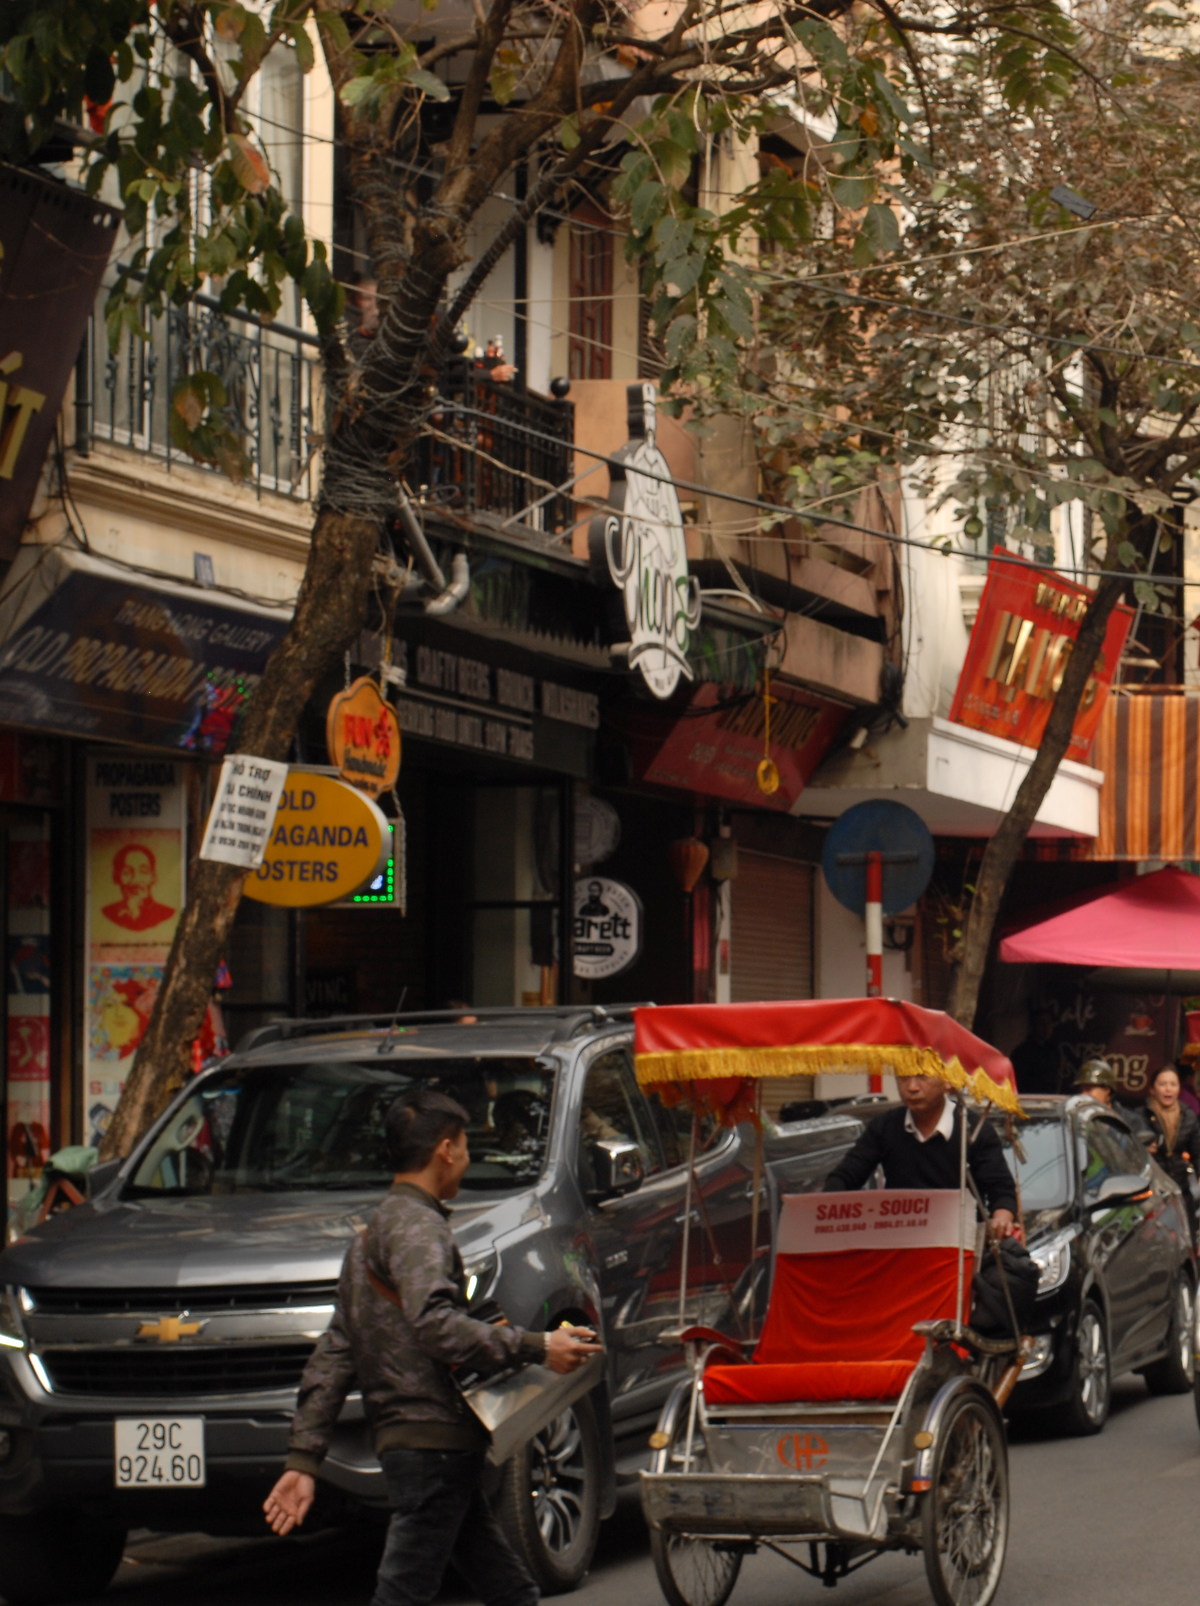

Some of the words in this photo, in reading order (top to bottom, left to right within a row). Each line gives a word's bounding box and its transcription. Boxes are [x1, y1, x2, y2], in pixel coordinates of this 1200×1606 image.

[2, 625, 69, 674] OLD
[46, 635, 195, 704] PROPAGANDA
[96, 763, 176, 788] PROPAGANDA
[108, 792, 163, 819] POSTERS
[269, 826, 370, 848] AGANDA
[250, 860, 339, 883] OSTERS
[816, 1203, 863, 1221] SANS
[879, 1198, 931, 1217] SOUCI
[136, 1422, 182, 1451] 29C
[118, 1454, 201, 1484] 924.60
